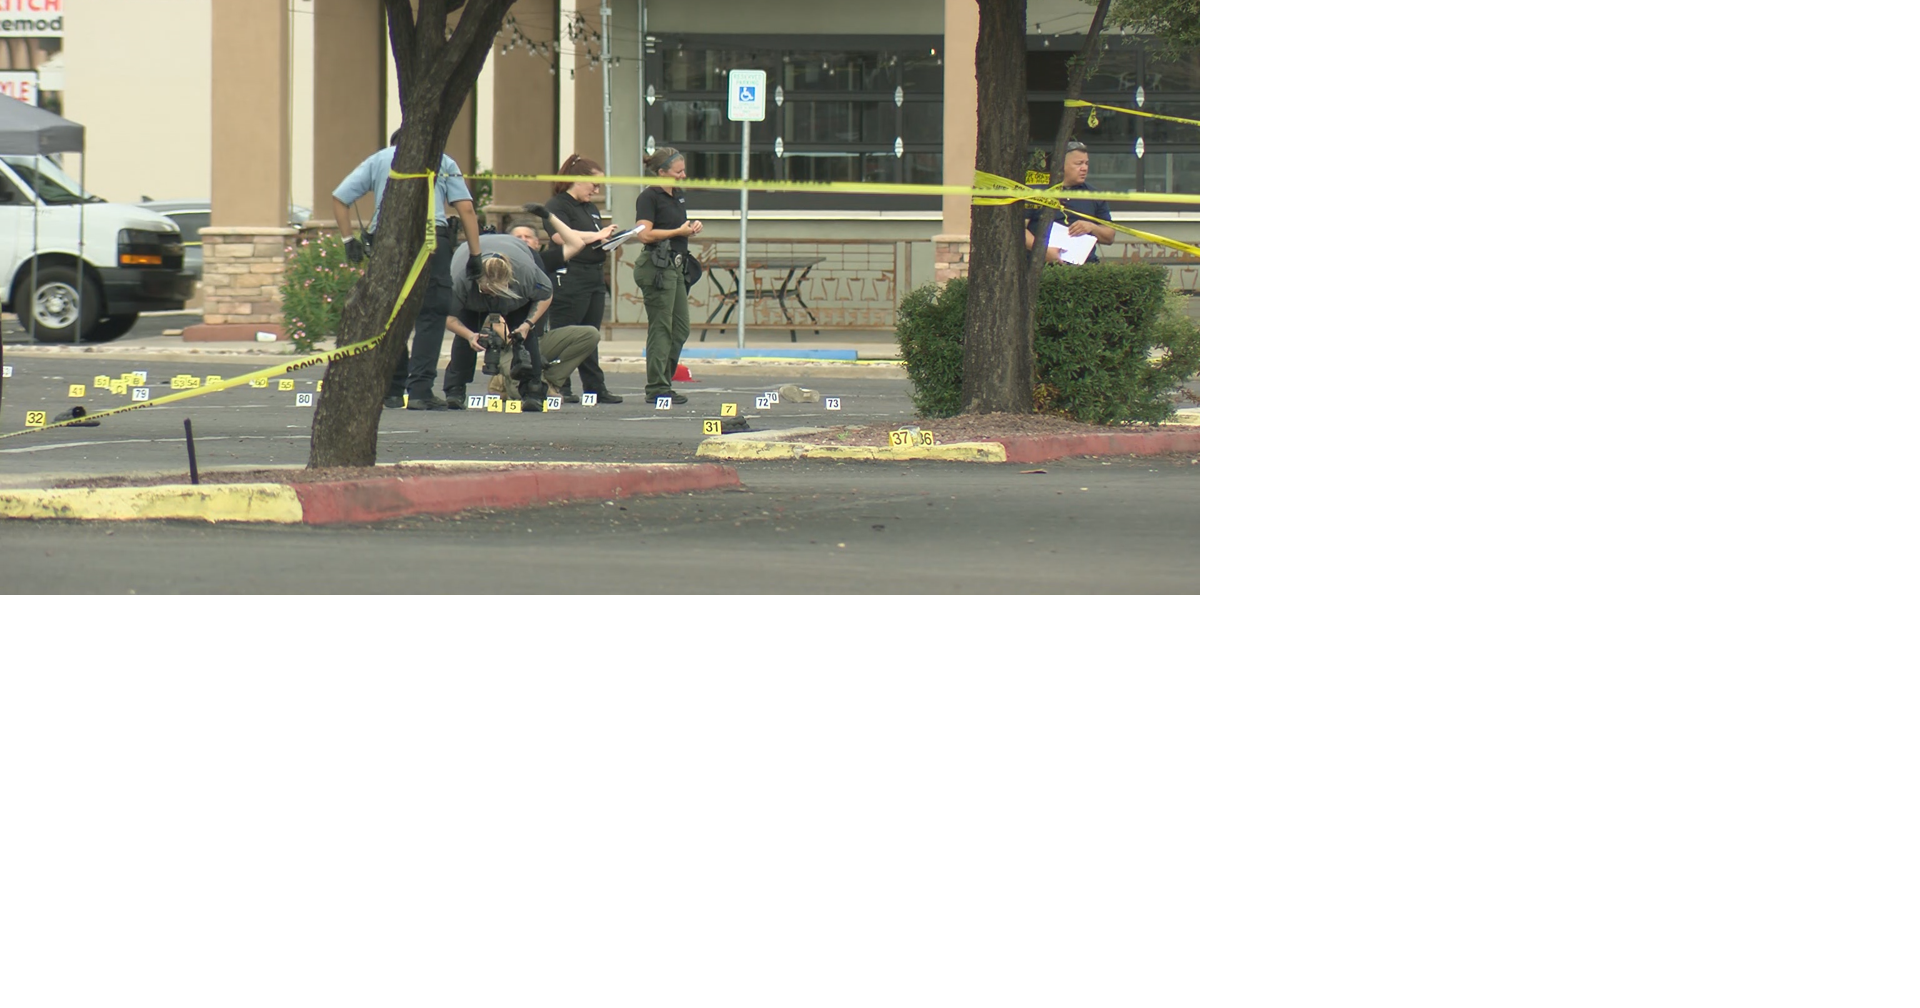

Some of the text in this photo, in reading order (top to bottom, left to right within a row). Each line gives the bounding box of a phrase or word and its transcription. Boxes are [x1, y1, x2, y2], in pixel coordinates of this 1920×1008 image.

[0, 16, 63, 31] emod
[135, 389, 147, 399] 79
[298, 394, 311, 404] 80
[584, 394, 594, 404] 71
[470, 396, 481, 406] 77
[548, 398, 559, 408] 76
[658, 399, 669, 408] 74
[757, 398, 769, 407] 72
[828, 399, 839, 408] 73
[27, 412, 44, 424] 32
[705, 421, 719, 433] 31
[892, 431, 908, 445] 37
